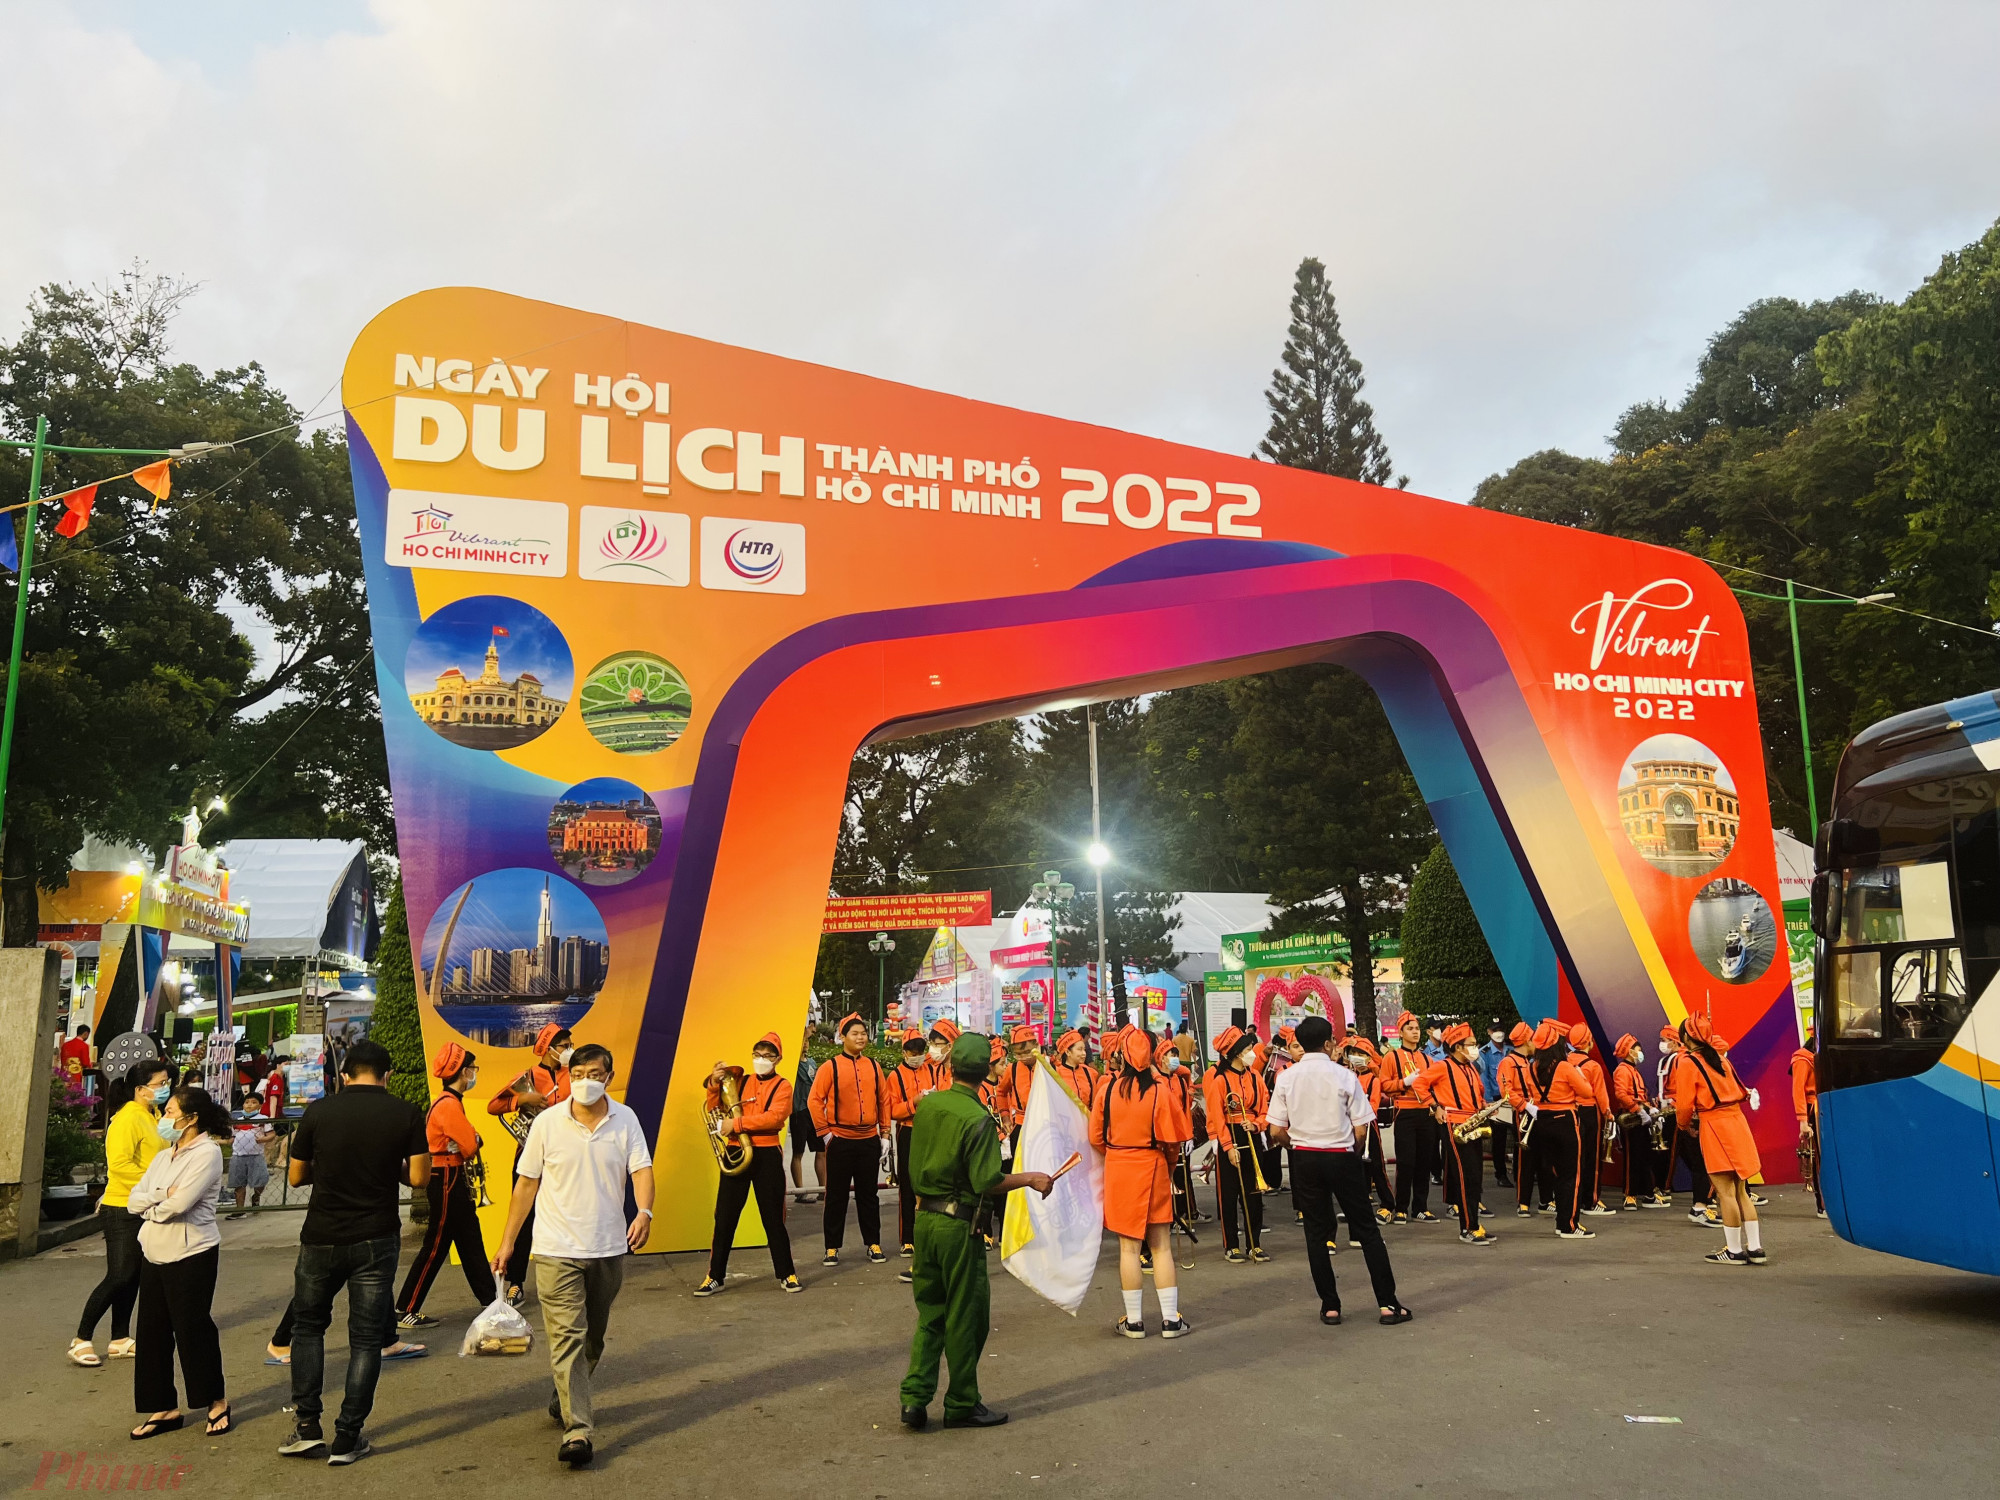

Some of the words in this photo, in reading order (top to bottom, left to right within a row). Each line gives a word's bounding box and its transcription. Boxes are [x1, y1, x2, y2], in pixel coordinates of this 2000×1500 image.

[394, 352, 549, 399] NGÀY
[574, 372, 670, 417] HỘI
[392, 396, 546, 471] DU
[580, 414, 805, 497] LỊCH
[816, 442, 953, 482] THÀNH
[963, 456, 1040, 489] PHỐ
[816, 472, 872, 504] HỒ
[882, 482, 940, 511] CHÍ
[951, 489, 1041, 519] MINH
[1060, 467, 1262, 538] 2022
[403, 543, 428, 557] HO
[432, 546, 461, 560] CHI
[465, 548, 507, 563] MINH
[509, 551, 550, 566] CITY
[449, 530, 551, 546] Vibrant
[739, 540, 774, 556] HTA
[1570, 578, 1720, 670] Vibrant
[1553, 672, 1590, 691] HO
[1593, 674, 1631, 693] CHI
[1634, 676, 1693, 696] MINH
[1694, 678, 1744, 698] CITY
[1613, 697, 1695, 720] 2022
[839, 910, 850, 918] LAO
[918, 905, 935, 915] THÍCH
